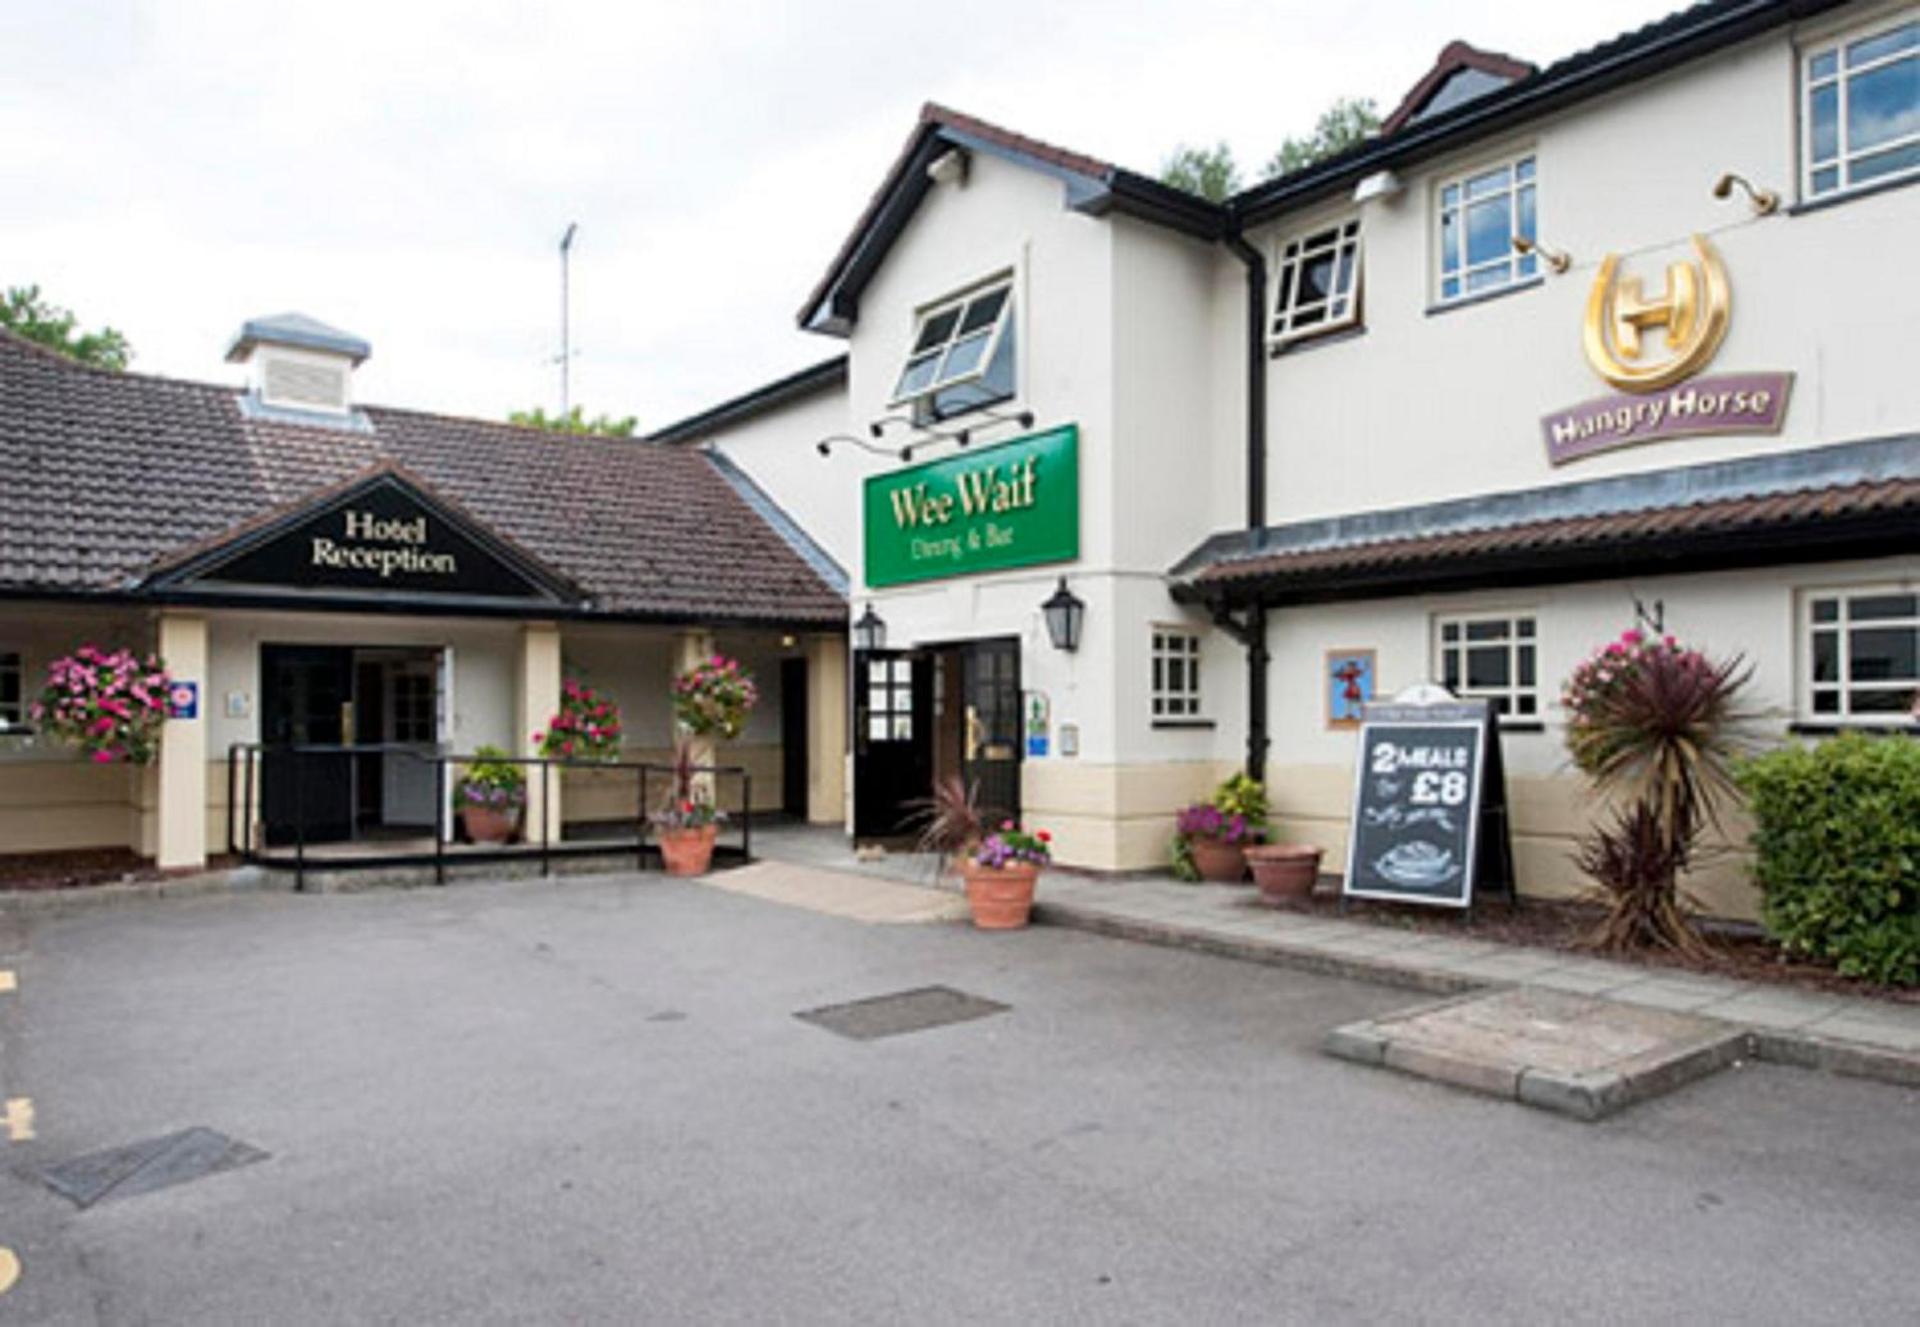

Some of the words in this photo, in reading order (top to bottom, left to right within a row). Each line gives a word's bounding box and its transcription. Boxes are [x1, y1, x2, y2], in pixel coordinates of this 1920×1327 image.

[1669, 388, 1770, 416] Horse
[890, 481, 953, 528] Wee
[956, 454, 1038, 516] Waif
[345, 510, 427, 544] Hotel
[312, 538, 456, 577] Reception
[1372, 741, 1397, 773] 2
[1397, 746, 1468, 768] MEALS
[1409, 770, 1468, 805] £8
